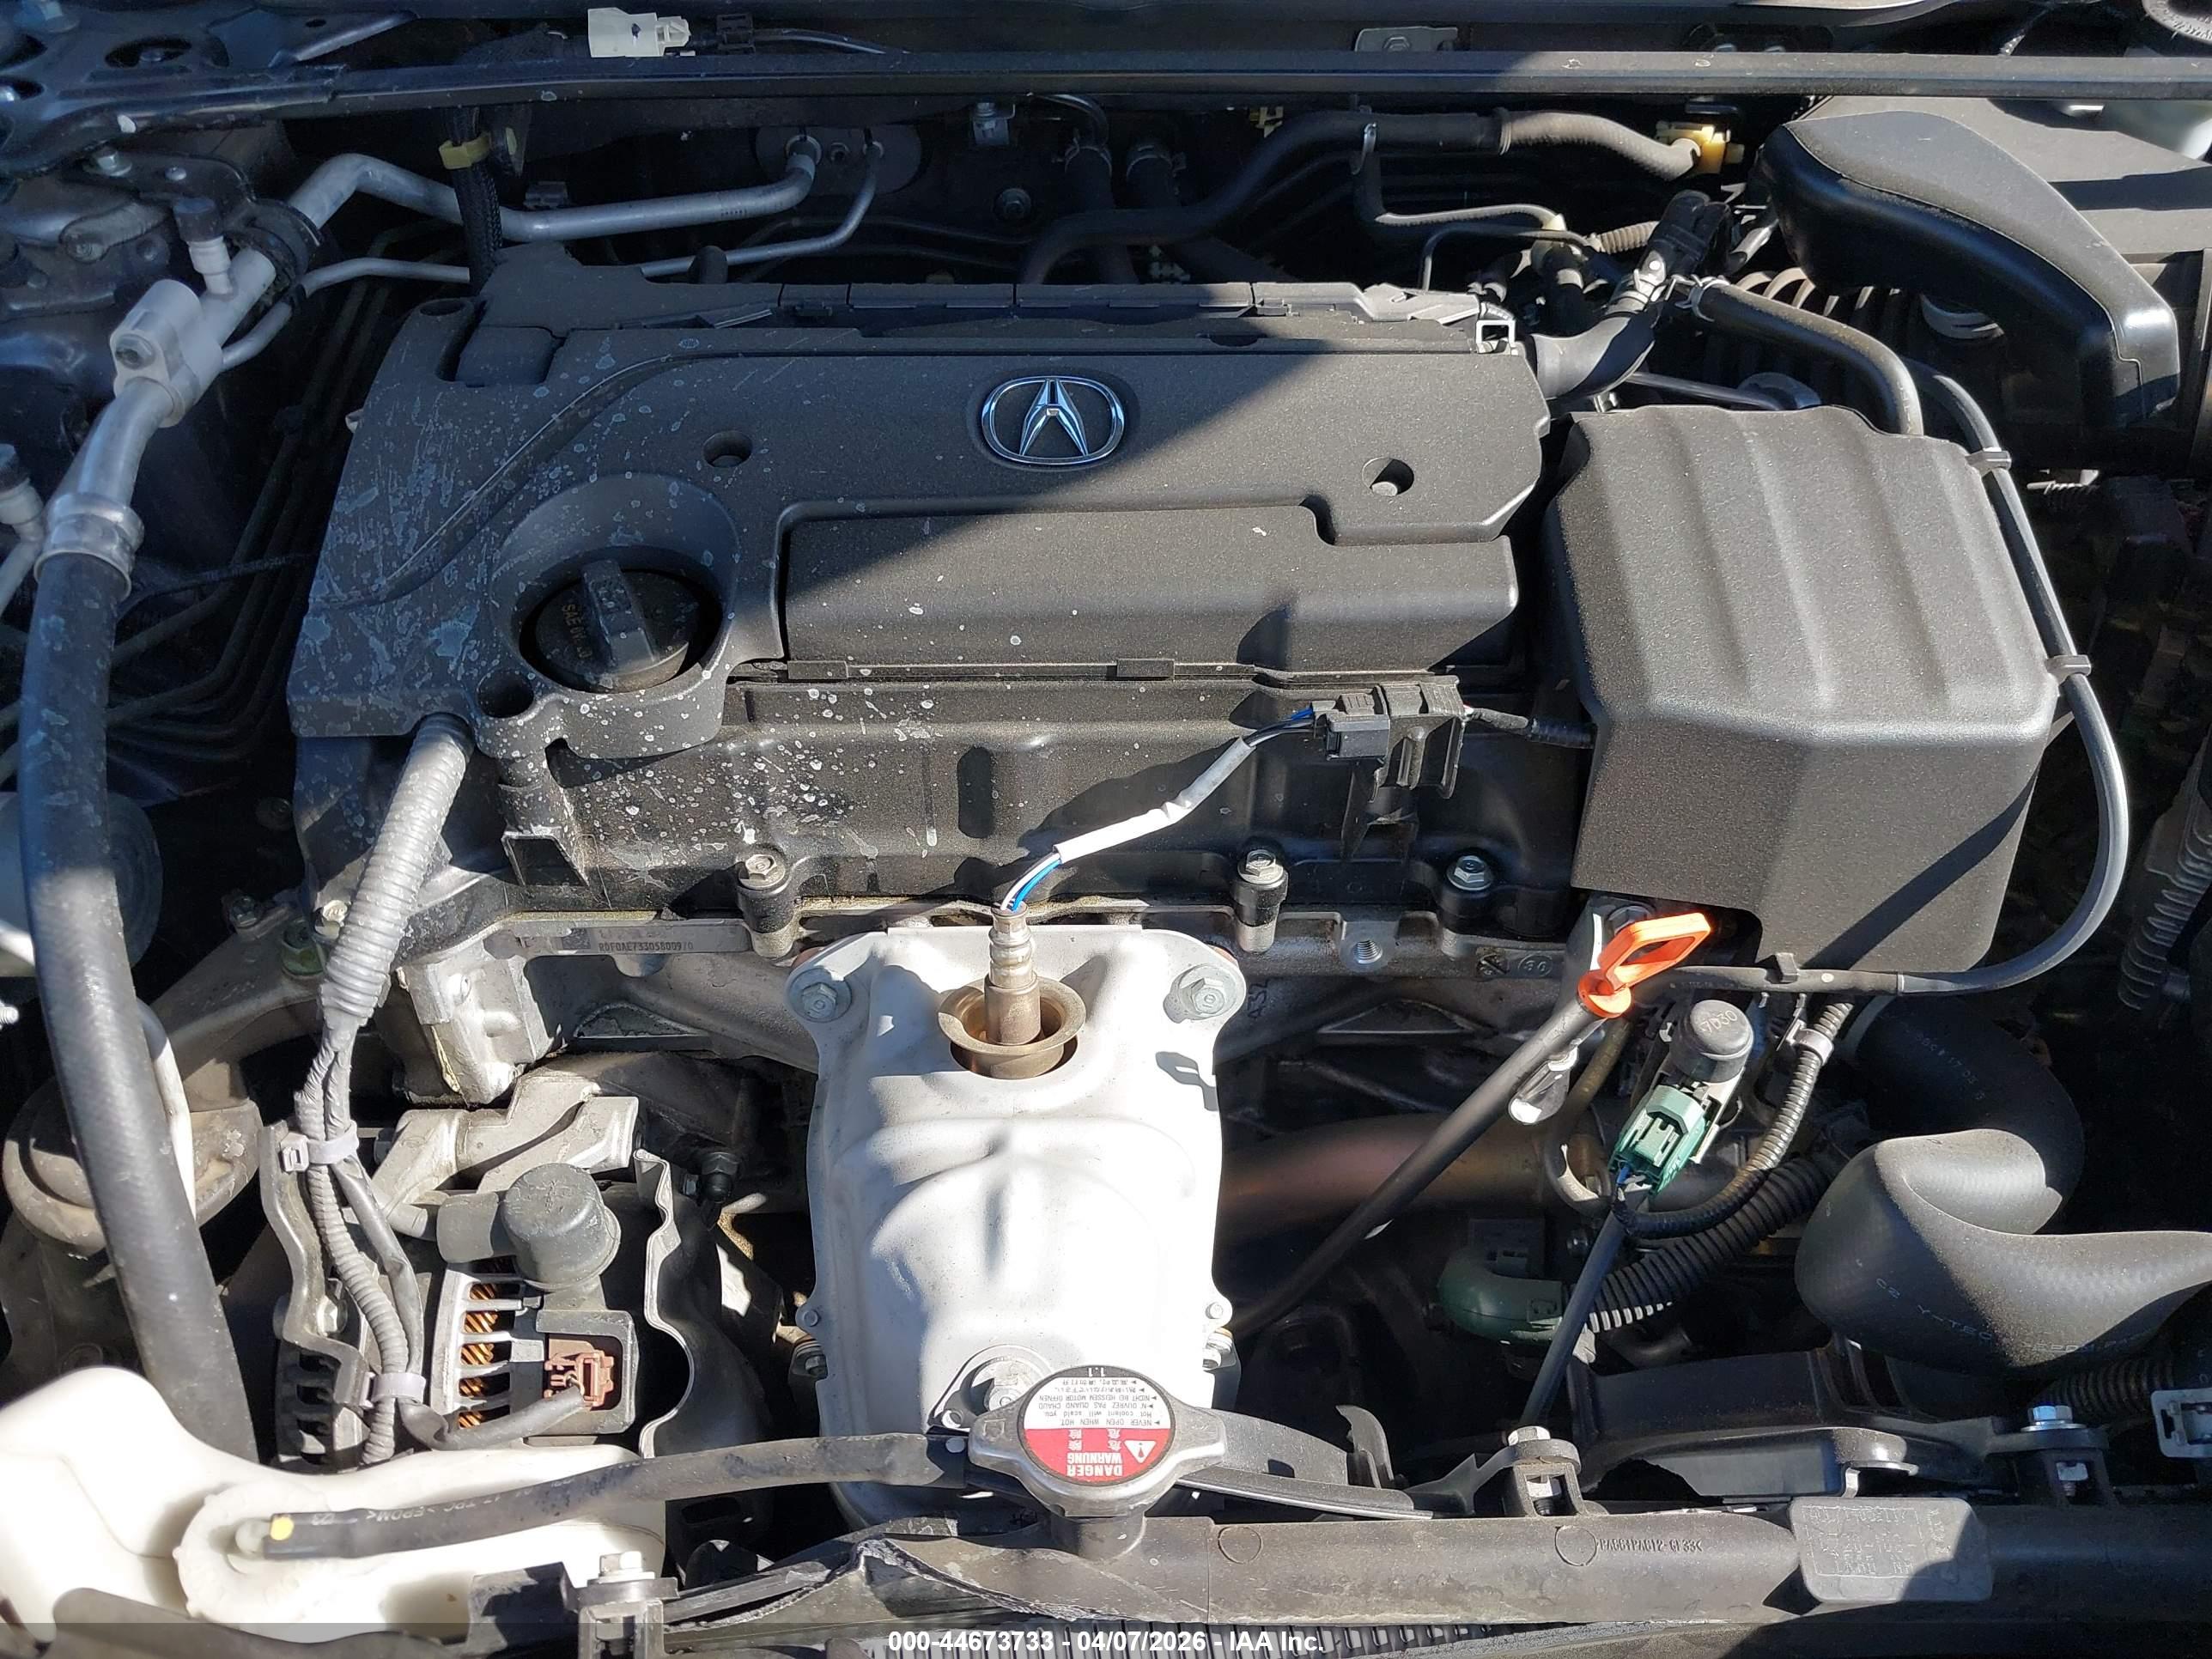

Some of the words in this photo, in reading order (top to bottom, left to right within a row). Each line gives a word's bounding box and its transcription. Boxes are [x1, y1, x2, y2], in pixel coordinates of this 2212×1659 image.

[1087, 1367, 1105, 1377] 1.1
[1066, 1452, 1122, 1464] WARNUNG
[1066, 1464, 1122, 1476] DANGER
